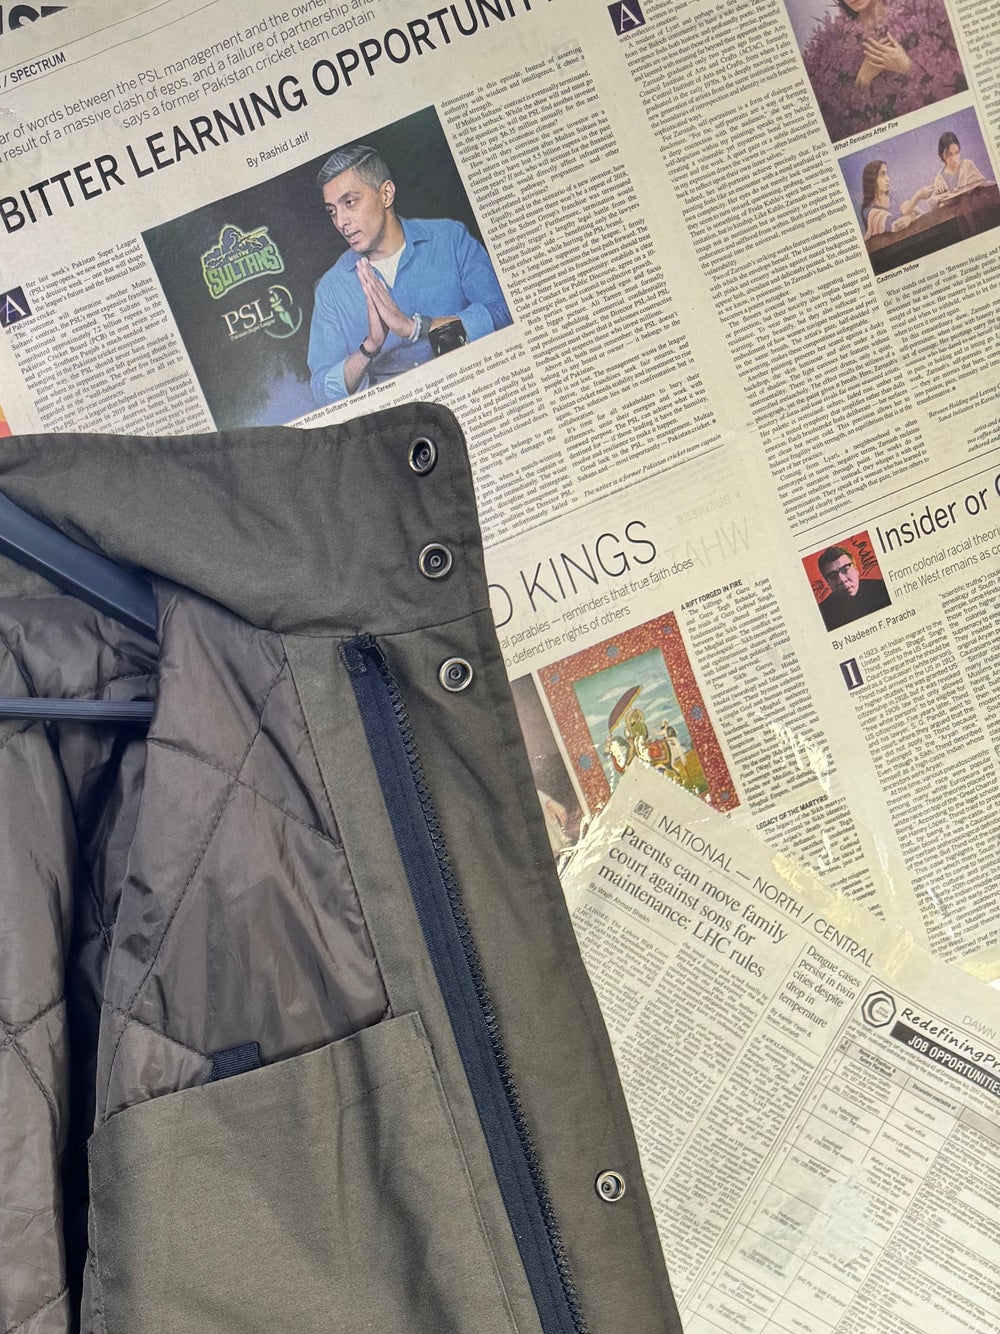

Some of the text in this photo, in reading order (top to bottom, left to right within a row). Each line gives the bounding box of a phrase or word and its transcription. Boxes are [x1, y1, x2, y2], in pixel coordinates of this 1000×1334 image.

[9, 52, 67, 83] SPECTRUM
[119, 10, 376, 129] says a former Pakistan cricket team captain
[125, 75, 309, 179] LEARNING
[245, 131, 310, 168] By Rashid Latif
[206, 244, 280, 295] SULTANS
[222, 300, 274, 336] PSL
[875, 489, 988, 554] Insider or
[519, 520, 657, 613] KINGS
[831, 608, 917, 651] By Nadeem F. Paracha
[608, 847, 756, 946] court against sons for
[620, 825, 788, 943] Parents can move family
[657, 815, 732, 873] NATIONAL
[752, 876, 804, 919] NORTH
[813, 918, 874, 968] CENTRAL
[597, 865, 765, 977] maintenance: LHC rules
[797, 958, 860, 1001] persist in twin
[806, 945, 862, 988] Dengue cases
[901, 1008, 1000, 1072] RedefiningPr
[907, 1035, 930, 1053] JOB
